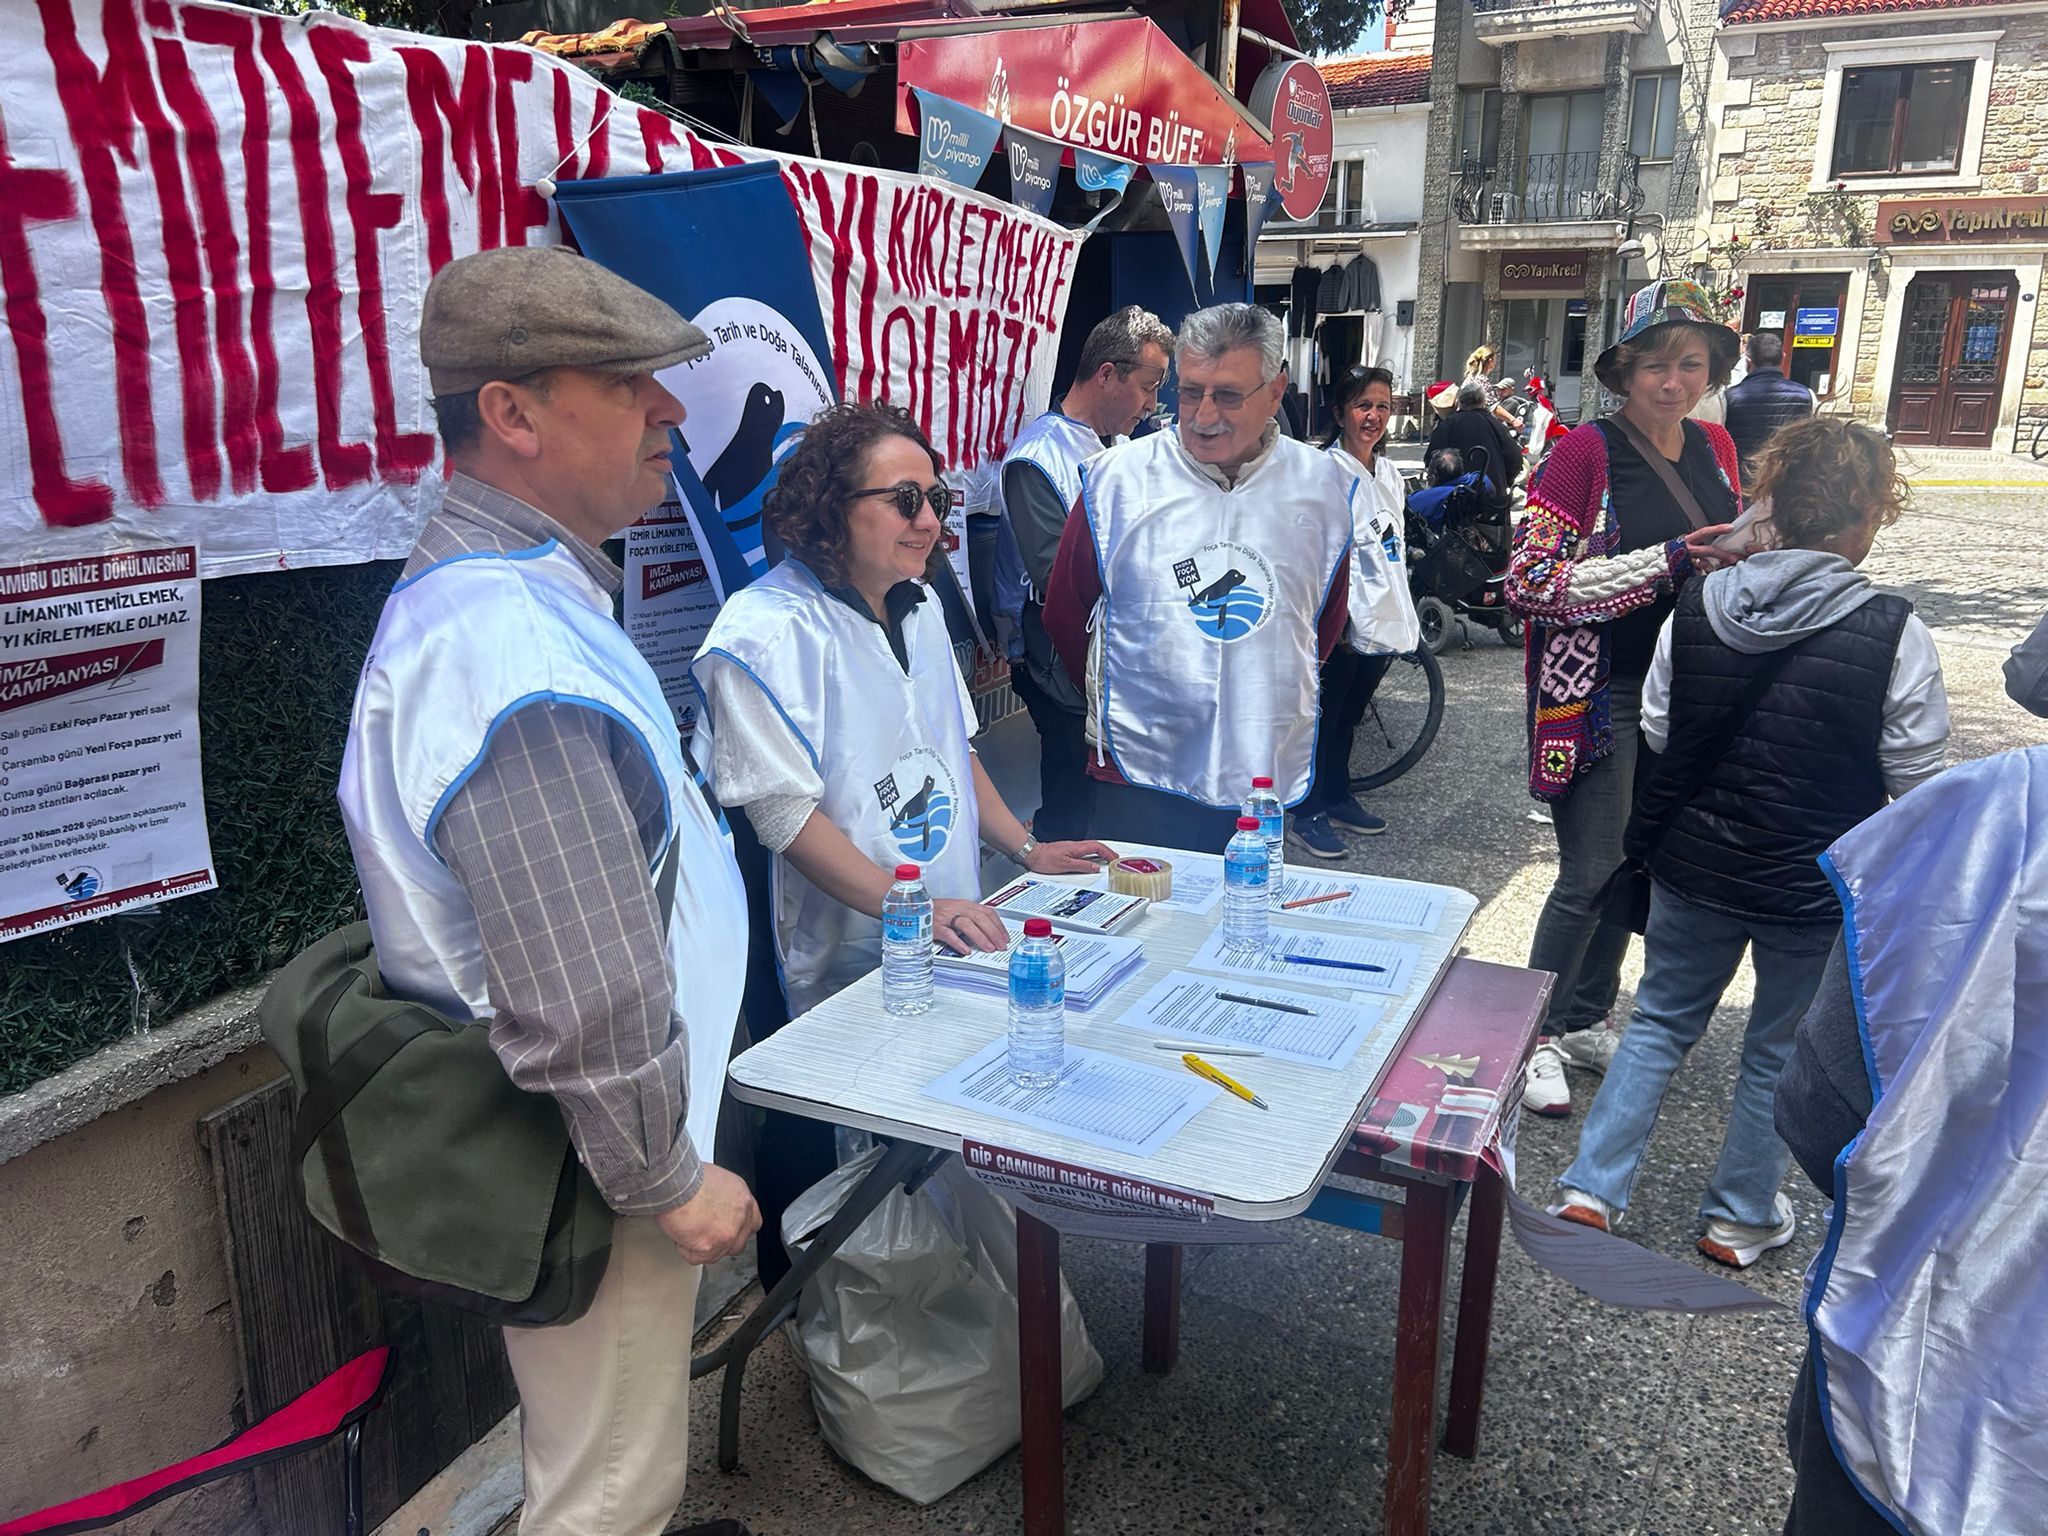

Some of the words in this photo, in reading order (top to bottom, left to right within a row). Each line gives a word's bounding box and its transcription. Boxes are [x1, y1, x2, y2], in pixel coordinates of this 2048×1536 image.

[1296, 85, 1323, 111] Sanal
[1050, 76, 1142, 156] ÖZGÜR
[1146, 109, 1204, 165] BÜFE
[1287, 100, 1324, 128] Oyunlar
[949, 132, 970, 147] milli
[944, 148, 981, 168] piyango
[1027, 157, 1040, 171] milli
[1025, 172, 1051, 190] piyango
[888, 185, 1075, 333] KİRLETMEKLE
[713, 321, 742, 345] Tarih
[743, 324, 758, 339] ve
[759, 323, 787, 353] Doğa
[790, 343, 829, 405] Talanına
[629, 529, 650, 541] İZMİR
[1203, 543, 1218, 552] Foça
[52, 562, 99, 588] DENİZE
[103, 553, 190, 581] DÖKÜLMESİN!
[1177, 565, 1195, 577] FOÇA
[1180, 572, 1198, 585] YOK
[5, 601, 83, 625] LİMANI'NI
[85, 588, 184, 614] TEMİZLEMEK,
[23, 618, 135, 647] KİRLETMEKLE
[138, 610, 190, 630] OLMAZ.
[22, 724, 48, 738] günü
[50, 718, 72, 731] Eski
[73, 715, 98, 727] Foça
[100, 710, 128, 723] Pazar
[129, 706, 149, 719] yeri
[150, 704, 171, 714] saat
[2, 755, 56, 772] Çarşamba
[58, 748, 83, 762] günü
[85, 743, 107, 755] Yeni
[109, 740, 133, 752] Foça
[134, 735, 162, 748] pazar
[163, 730, 182, 743] yeri
[4, 790, 34, 801] Cuma
[37, 782, 62, 797] günü
[64, 773, 110, 789] Bağarası
[112, 768, 140, 782] pazar
[141, 762, 161, 776] yeri
[11, 803, 36, 815] imza
[882, 789, 898, 806] YOK
[19, 847, 30, 855] ve
[99, 823, 138, 838] Bakanlığı
[139, 821, 148, 829] ve
[149, 817, 170, 828] İzmir
[22, 832, 34, 841] 30
[35, 828, 60, 839] Nisan
[86, 816, 107, 829] günü
[34, 914, 66, 931] DOĞA
[970, 1146, 992, 1166] DİP
[996, 1153, 1056, 1181] ÇAMURU
[1060, 1169, 1108, 1193] DENİZE
